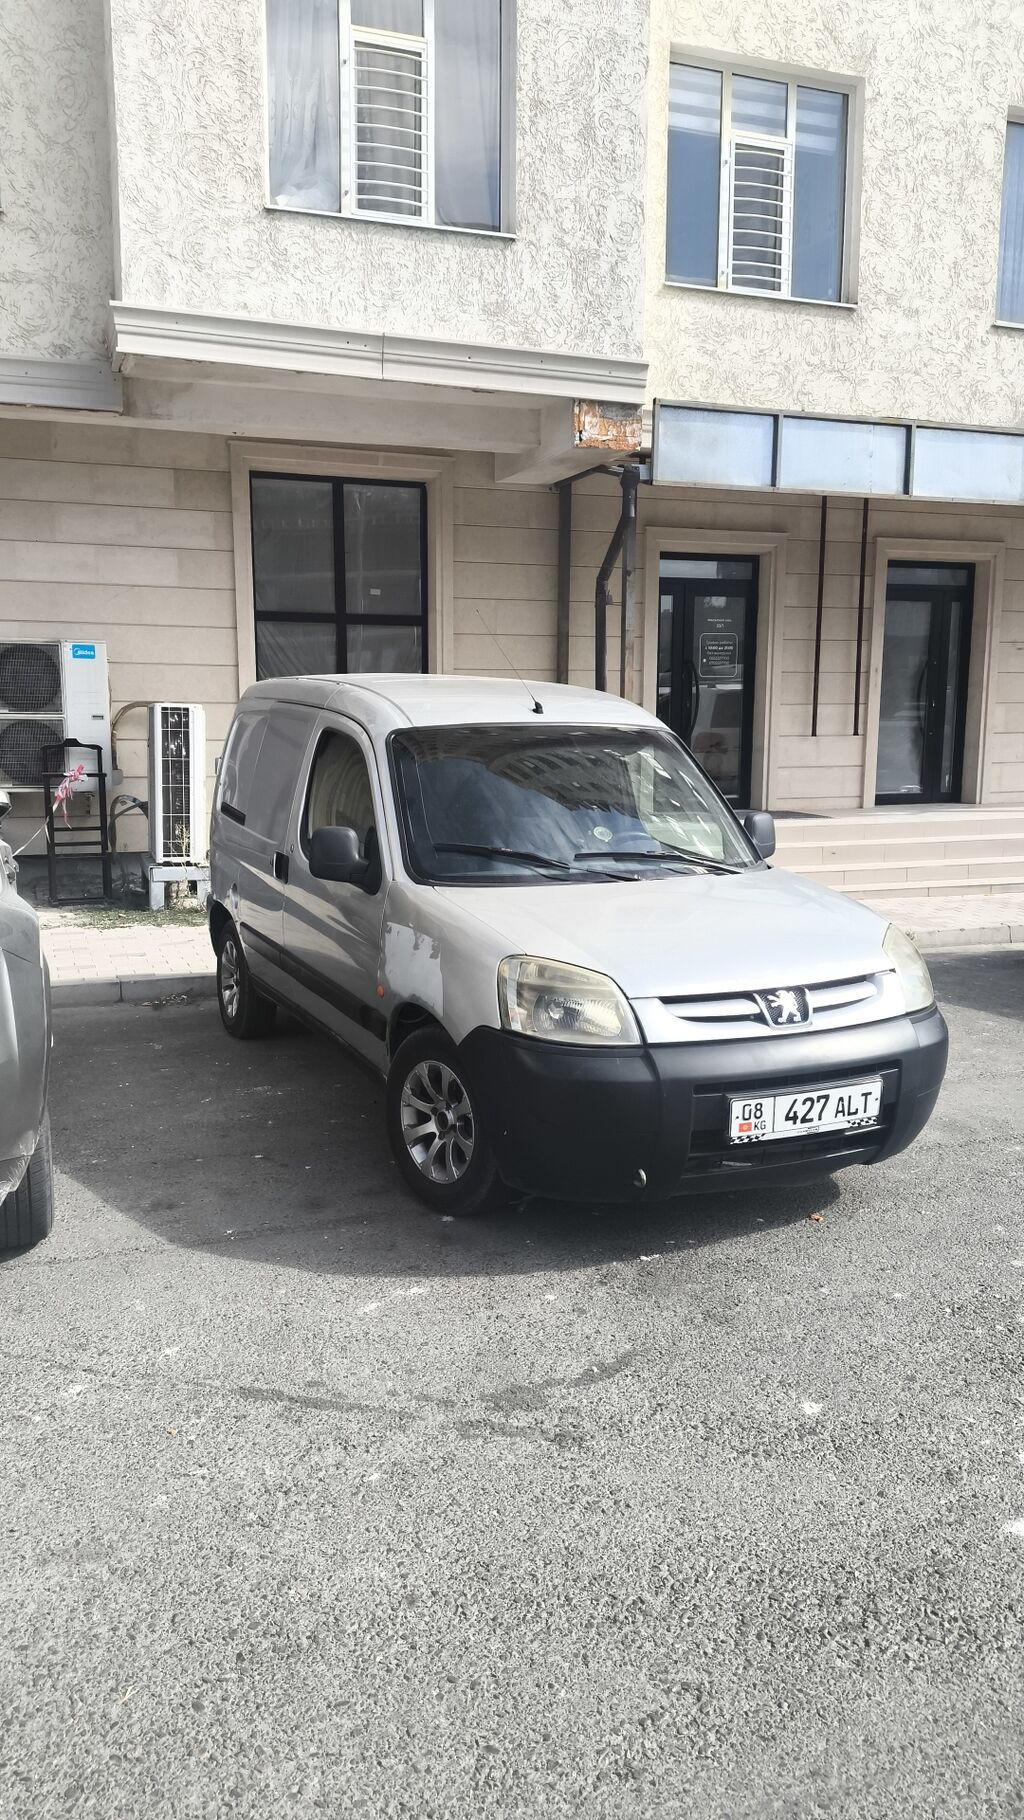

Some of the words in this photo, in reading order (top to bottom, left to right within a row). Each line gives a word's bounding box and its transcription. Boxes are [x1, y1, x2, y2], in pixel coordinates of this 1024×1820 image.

[742, 1103, 763, 1121] 08
[784, 1094, 830, 1126] 427
[834, 1091, 873, 1119] ALT
[753, 1120, 767, 1131] KG
